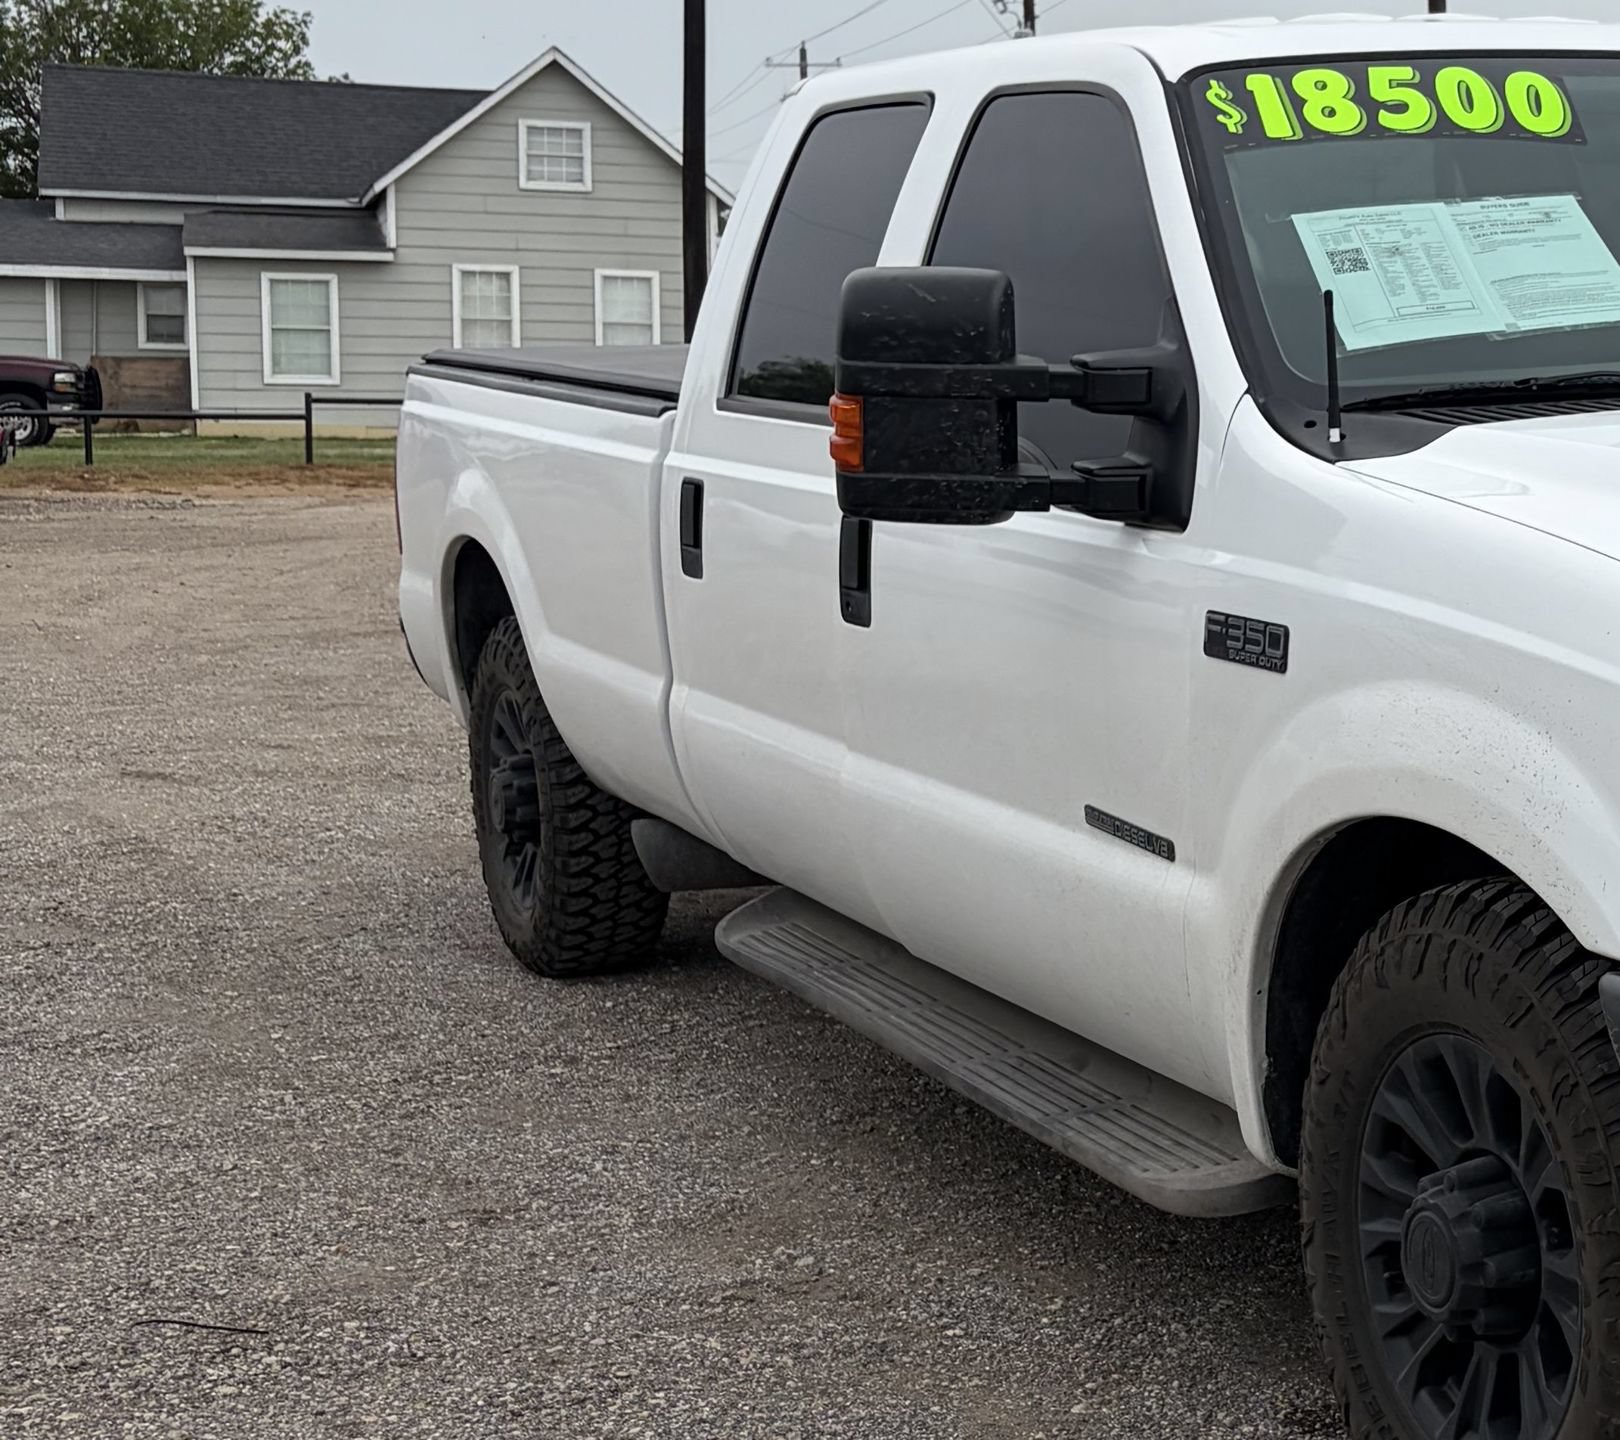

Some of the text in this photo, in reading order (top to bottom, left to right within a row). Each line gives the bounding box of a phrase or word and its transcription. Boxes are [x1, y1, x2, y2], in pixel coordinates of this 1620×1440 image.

[1205, 66, 1573, 140] $18500
[1205, 612, 1285, 658] F-350
[1228, 649, 1285, 672] SUPER DUTY
